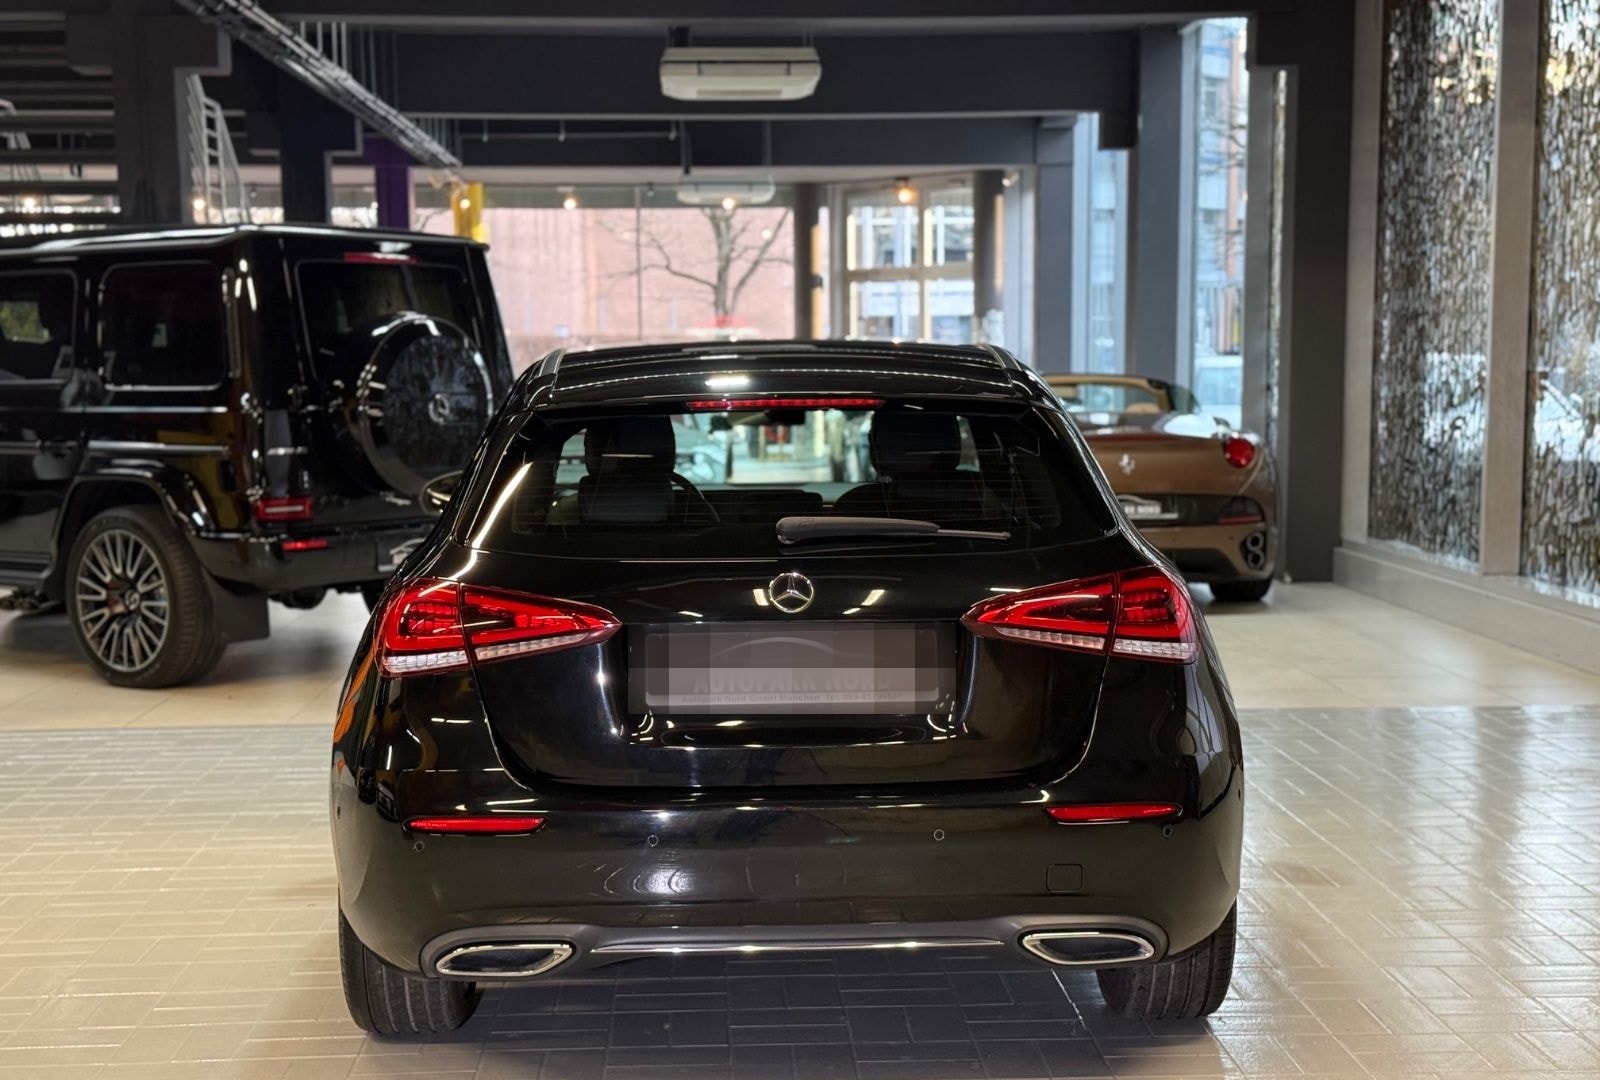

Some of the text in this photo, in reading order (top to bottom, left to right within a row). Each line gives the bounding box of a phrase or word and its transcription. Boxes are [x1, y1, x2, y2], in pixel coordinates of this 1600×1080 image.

[692, 668, 892, 693] AUTOPARK NORD
[681, 694, 721, 704] Autopark
[725, 694, 747, 702] Nord
[749, 694, 777, 702] GmbH
